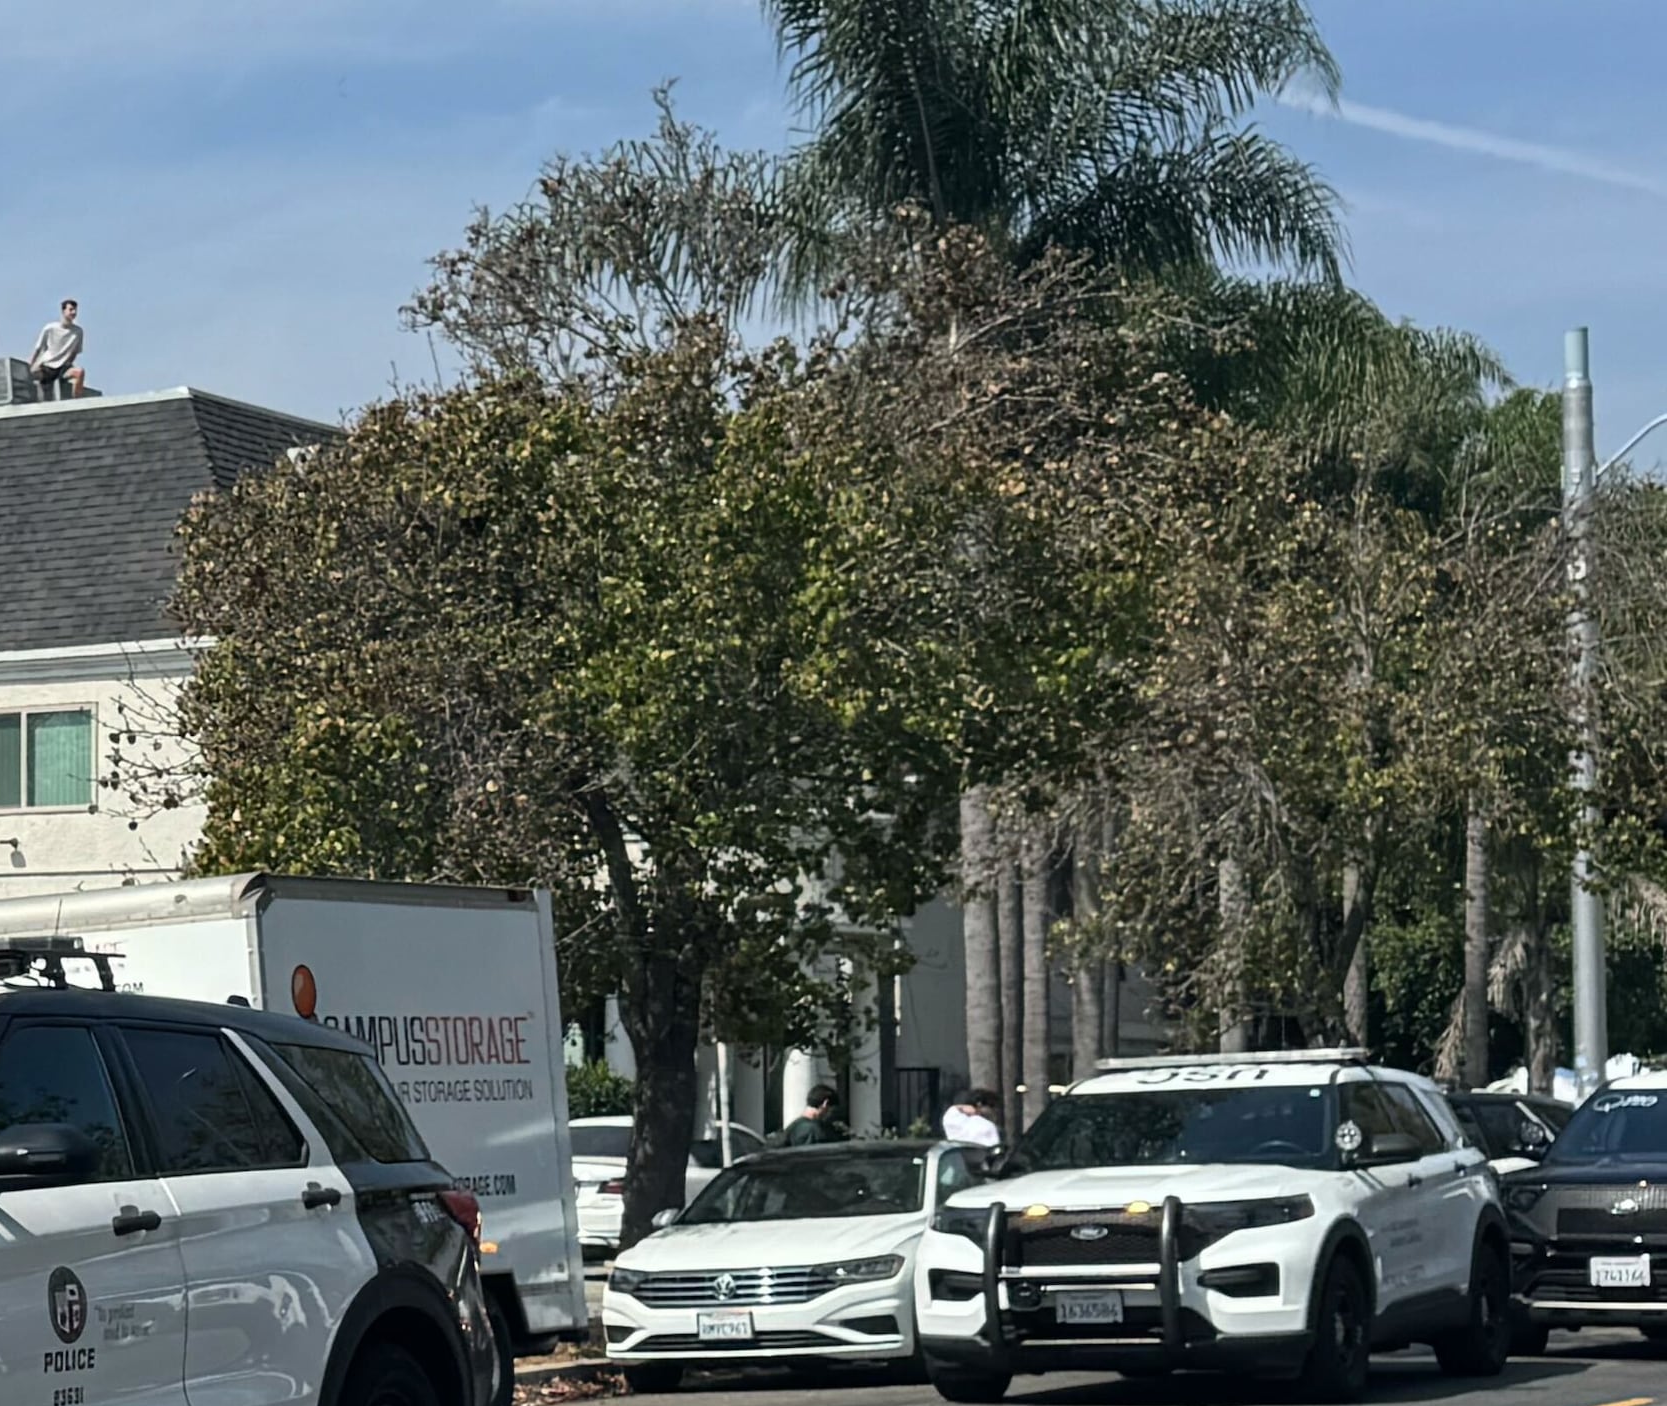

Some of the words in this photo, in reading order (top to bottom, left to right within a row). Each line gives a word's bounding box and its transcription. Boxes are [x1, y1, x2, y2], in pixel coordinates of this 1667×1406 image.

[323, 1016, 531, 1066] MPUSSTORAGE
[473, 1078, 534, 1102] SOLUTION
[44, 1348, 95, 1373] POLICE
